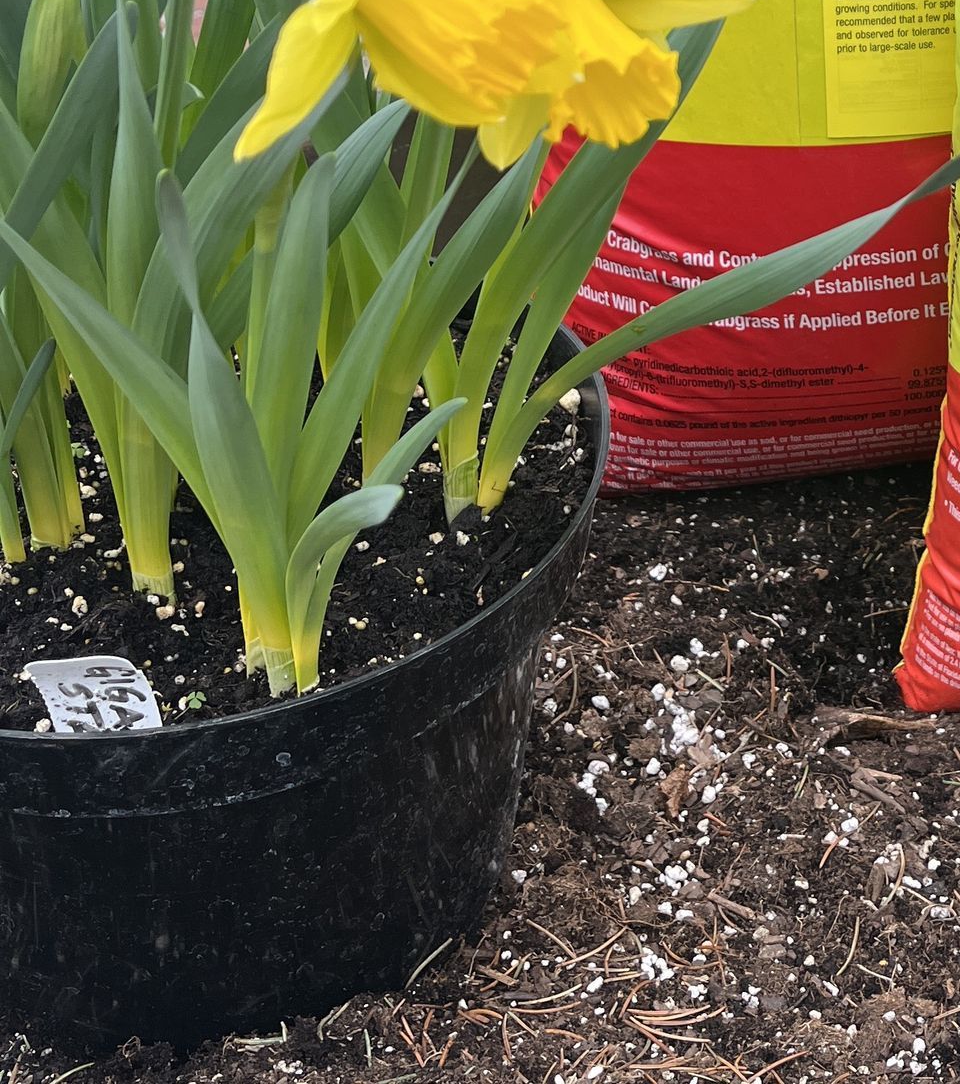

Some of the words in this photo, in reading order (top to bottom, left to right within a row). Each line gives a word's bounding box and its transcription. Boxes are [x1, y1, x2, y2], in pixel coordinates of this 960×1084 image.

[835, 4, 870, 16] growing
[872, 1, 918, 13] conditions.
[923, 0, 937, 10] For
[835, 15, 897, 28] recommended
[898, 14, 916, 25] that
[925, 12, 940, 23] few
[836, 30, 852, 40] and
[855, 28, 894, 39] observed
[911, 25, 950, 37] tolerance
[836, 43, 856, 55] prior
[869, 40, 916, 53] large-scale
[607, 230, 679, 263] Crabgrass
[682, 250, 714, 268] and
[922, 243, 940, 260] of
[814, 273, 916, 296] Established
[611, 293, 637, 315] Will
[783, 313, 795, 329] if
[798, 311, 861, 332] Applied
[866, 306, 920, 326] Before
